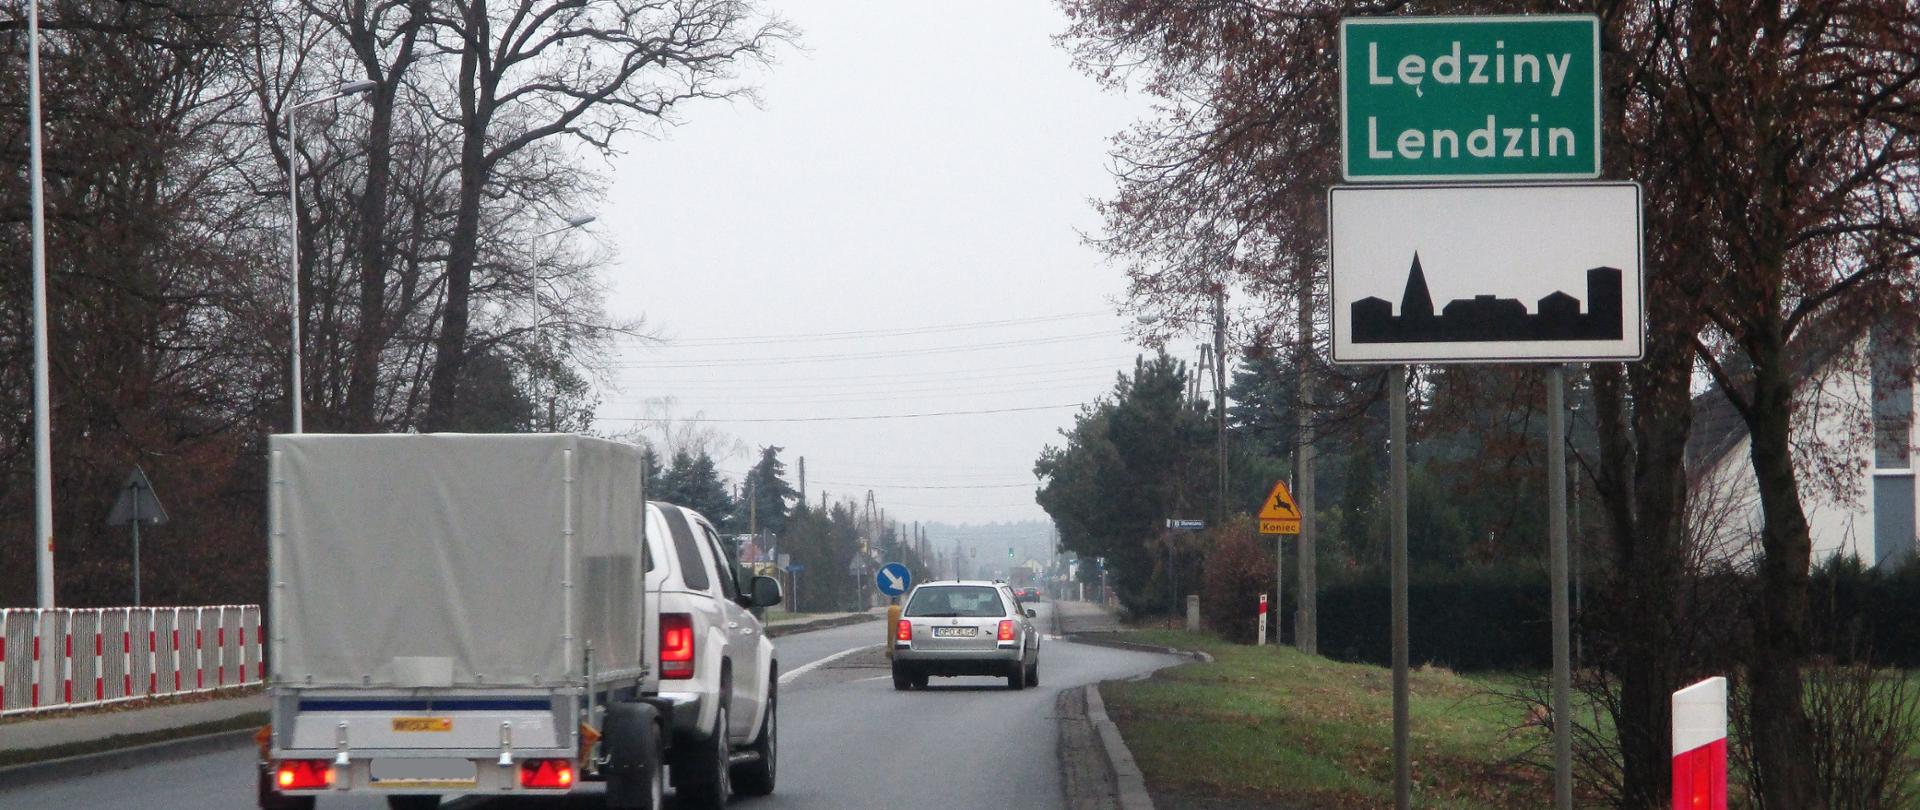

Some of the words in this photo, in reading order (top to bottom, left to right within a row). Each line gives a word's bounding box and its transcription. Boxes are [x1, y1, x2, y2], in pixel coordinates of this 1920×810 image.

[1368, 40, 1571, 98] Lędziny
[1367, 113, 1576, 160] Lendzin
[1263, 522, 1296, 532] Koniec
